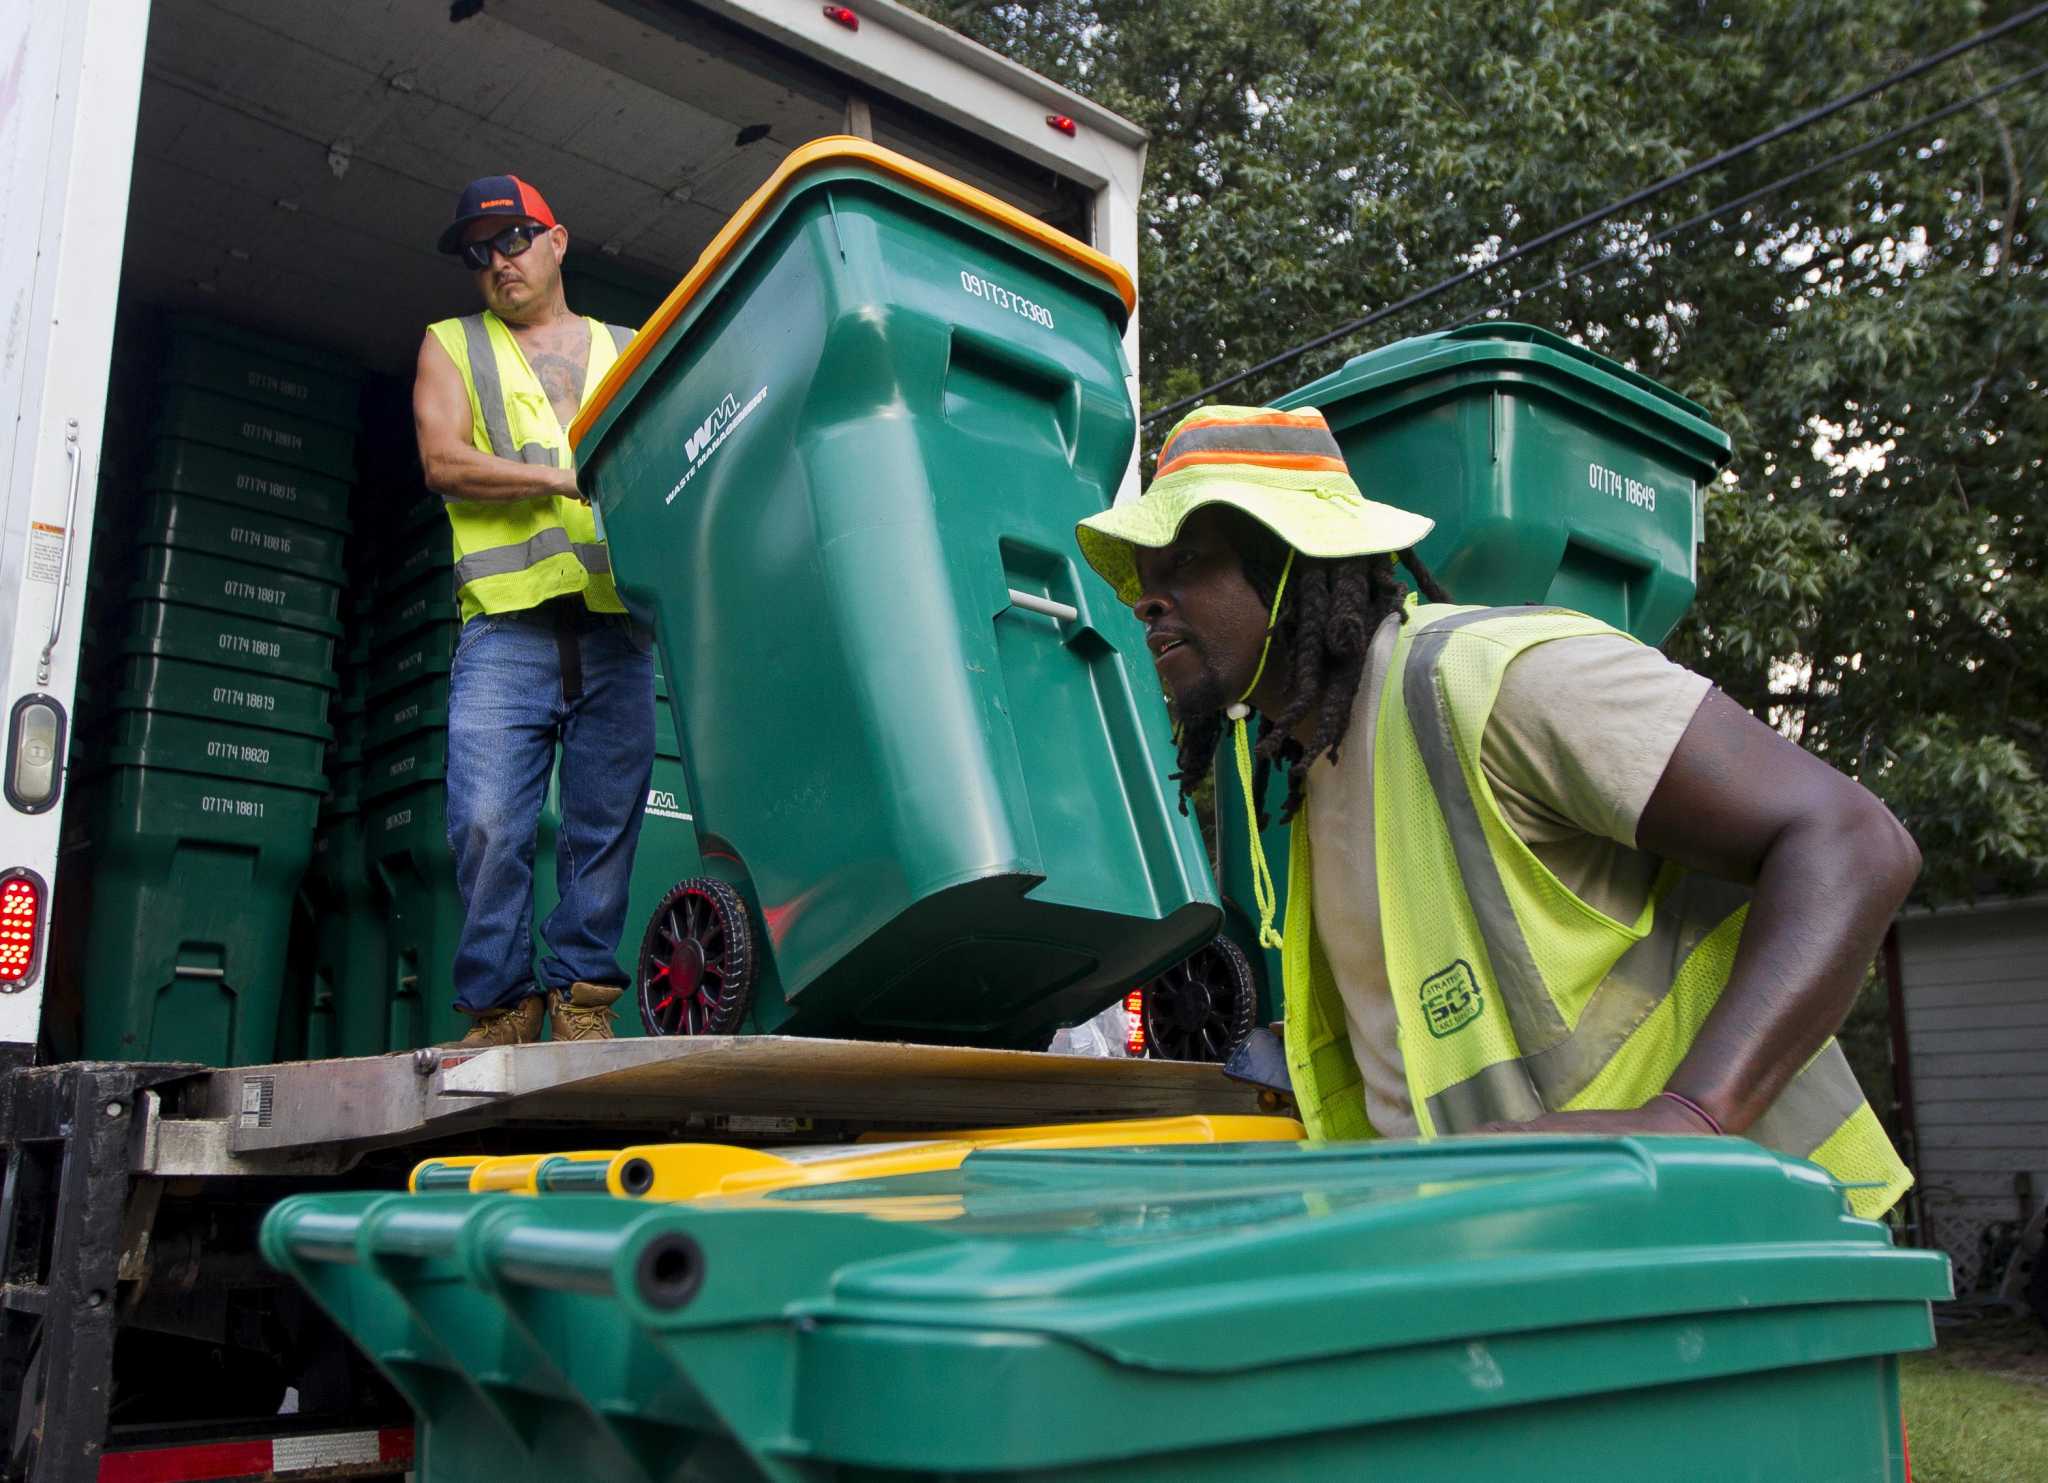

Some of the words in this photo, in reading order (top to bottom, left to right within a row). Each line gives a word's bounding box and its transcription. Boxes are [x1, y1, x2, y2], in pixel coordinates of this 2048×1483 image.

[960, 271, 1054, 329] 0917373380
[665, 465, 697, 505] WASTE
[697, 385, 768, 468] MANAGEMENT
